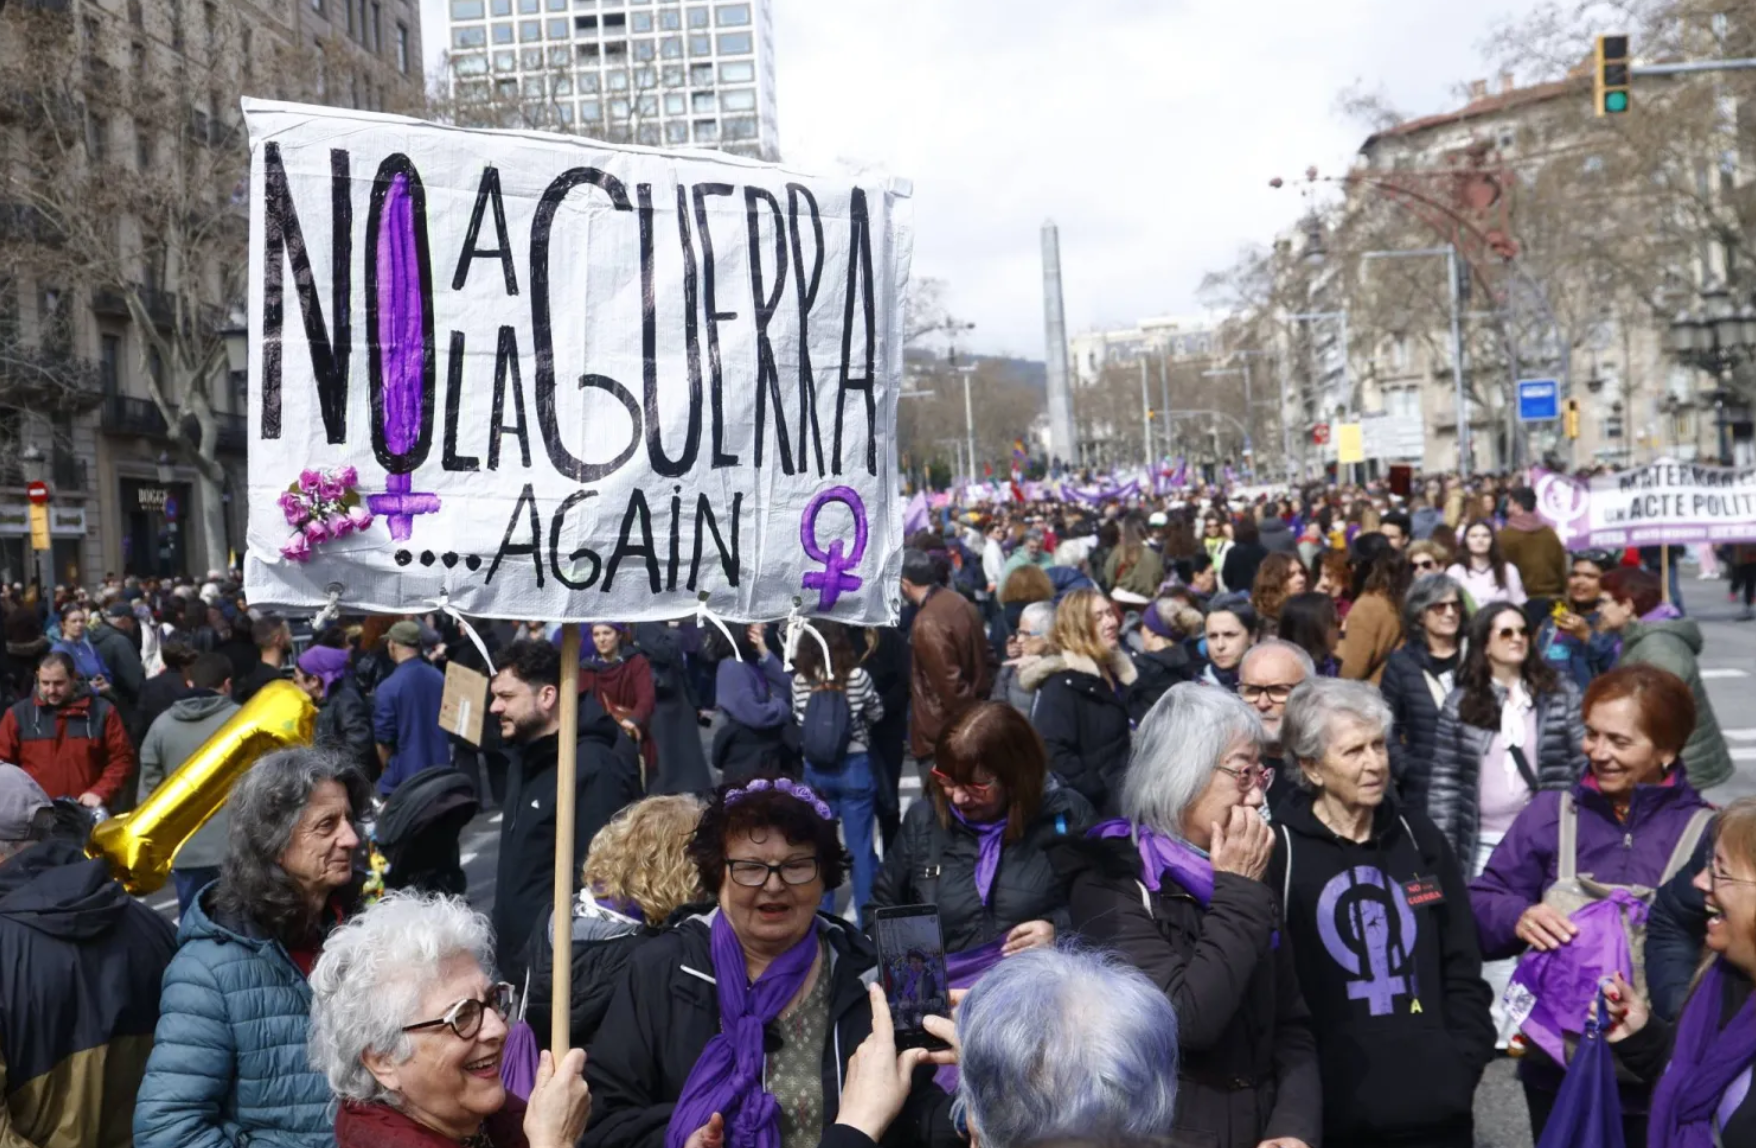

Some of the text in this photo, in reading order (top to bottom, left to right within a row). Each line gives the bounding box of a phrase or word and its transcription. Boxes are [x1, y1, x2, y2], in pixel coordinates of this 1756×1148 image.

[260, 141, 876, 483] NO A LA GUERRA
[1629, 493, 1685, 520] ACTE
